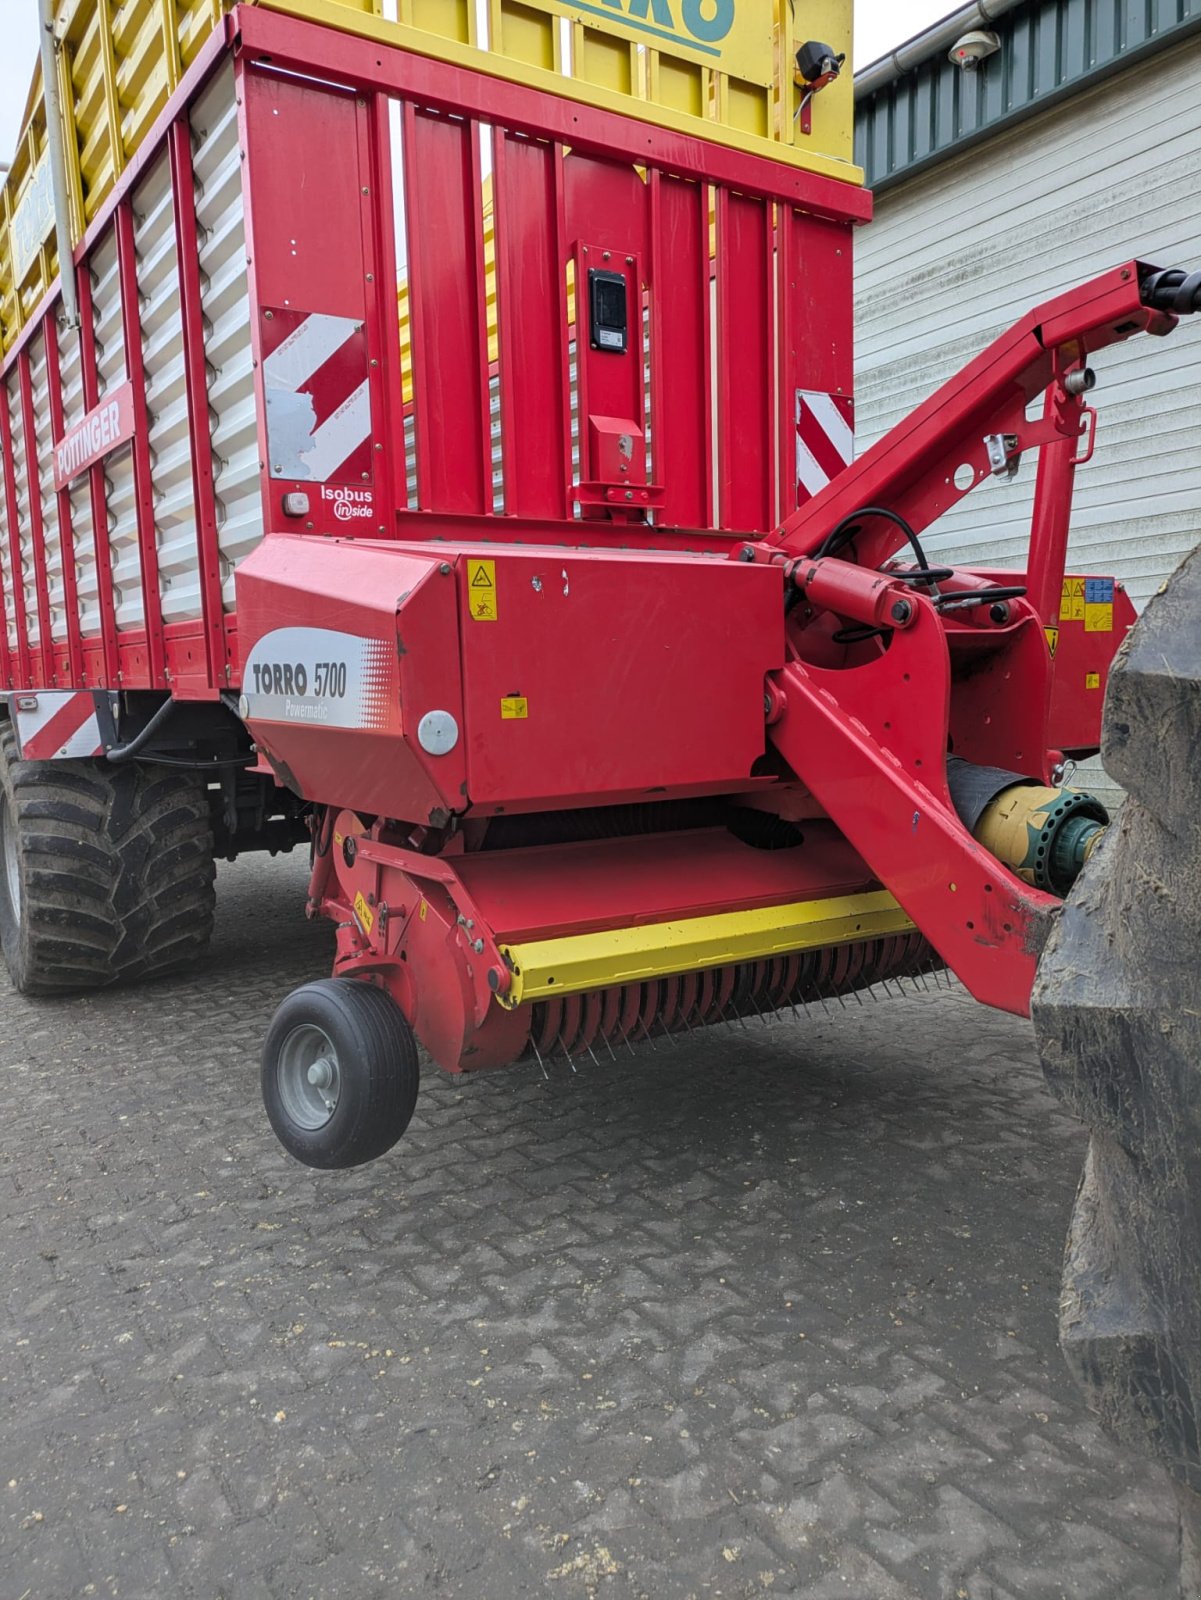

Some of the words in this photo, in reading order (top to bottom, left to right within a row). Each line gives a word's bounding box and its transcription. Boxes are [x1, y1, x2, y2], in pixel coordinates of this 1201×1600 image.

[321, 485, 372, 502] Isobus
[253, 663, 307, 696] TORRO
[314, 662, 347, 698] 5700
[285, 699, 328, 719] Powermatic
